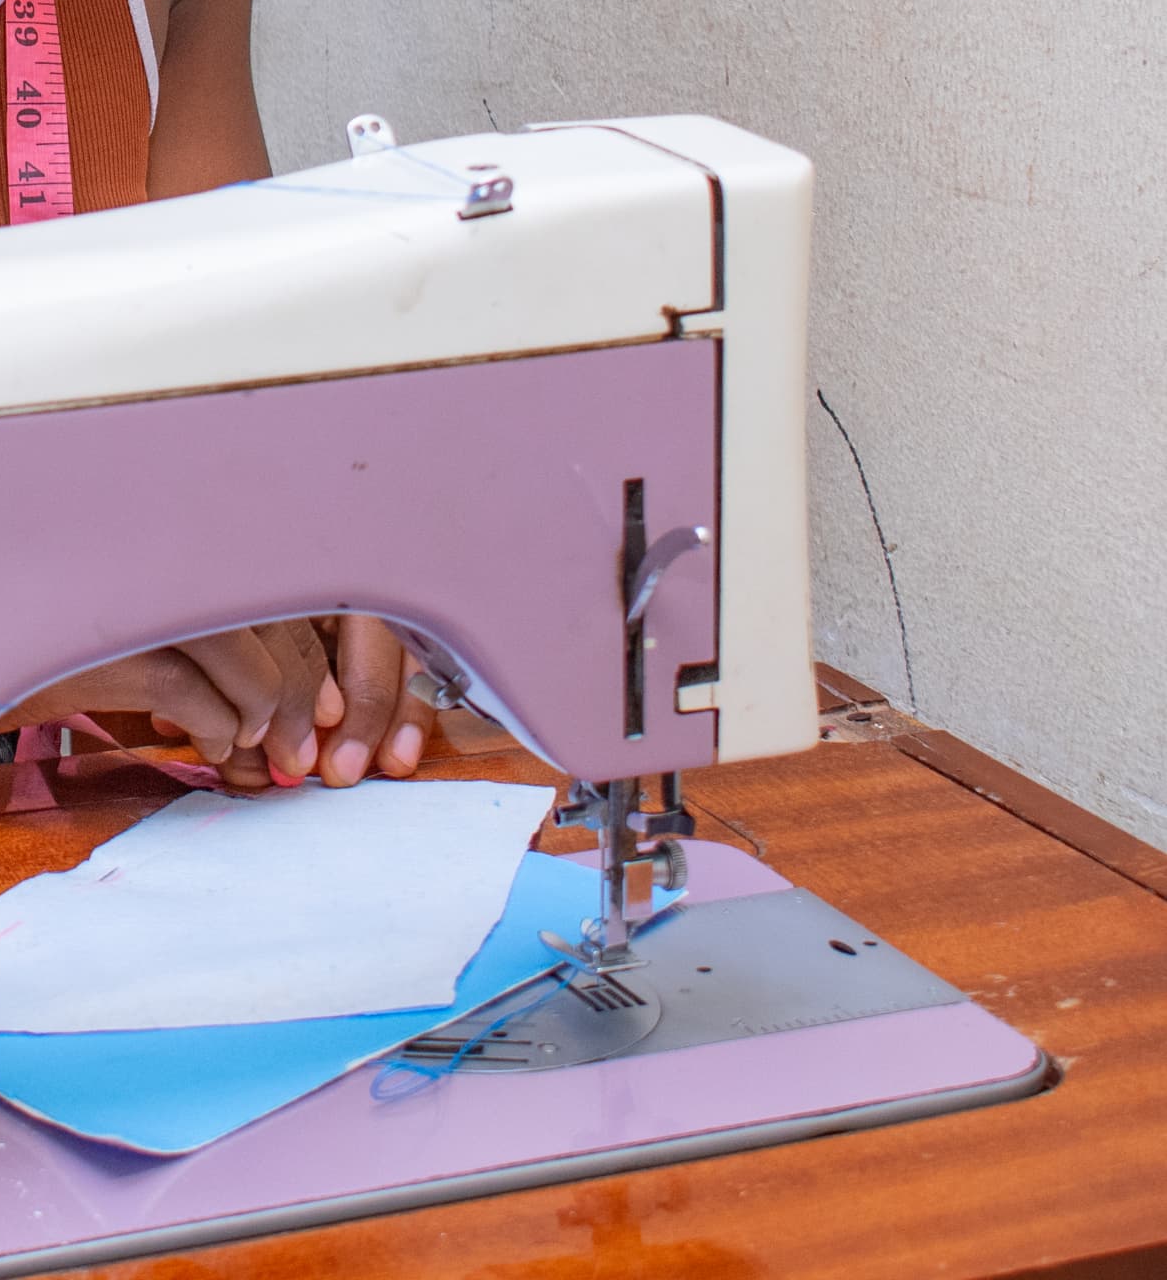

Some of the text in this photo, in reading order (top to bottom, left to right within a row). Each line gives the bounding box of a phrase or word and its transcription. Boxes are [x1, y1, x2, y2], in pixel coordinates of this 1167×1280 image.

[13, 0, 39, 47] 39
[16, 80, 42, 129] 40
[18, 161, 47, 208] 41
